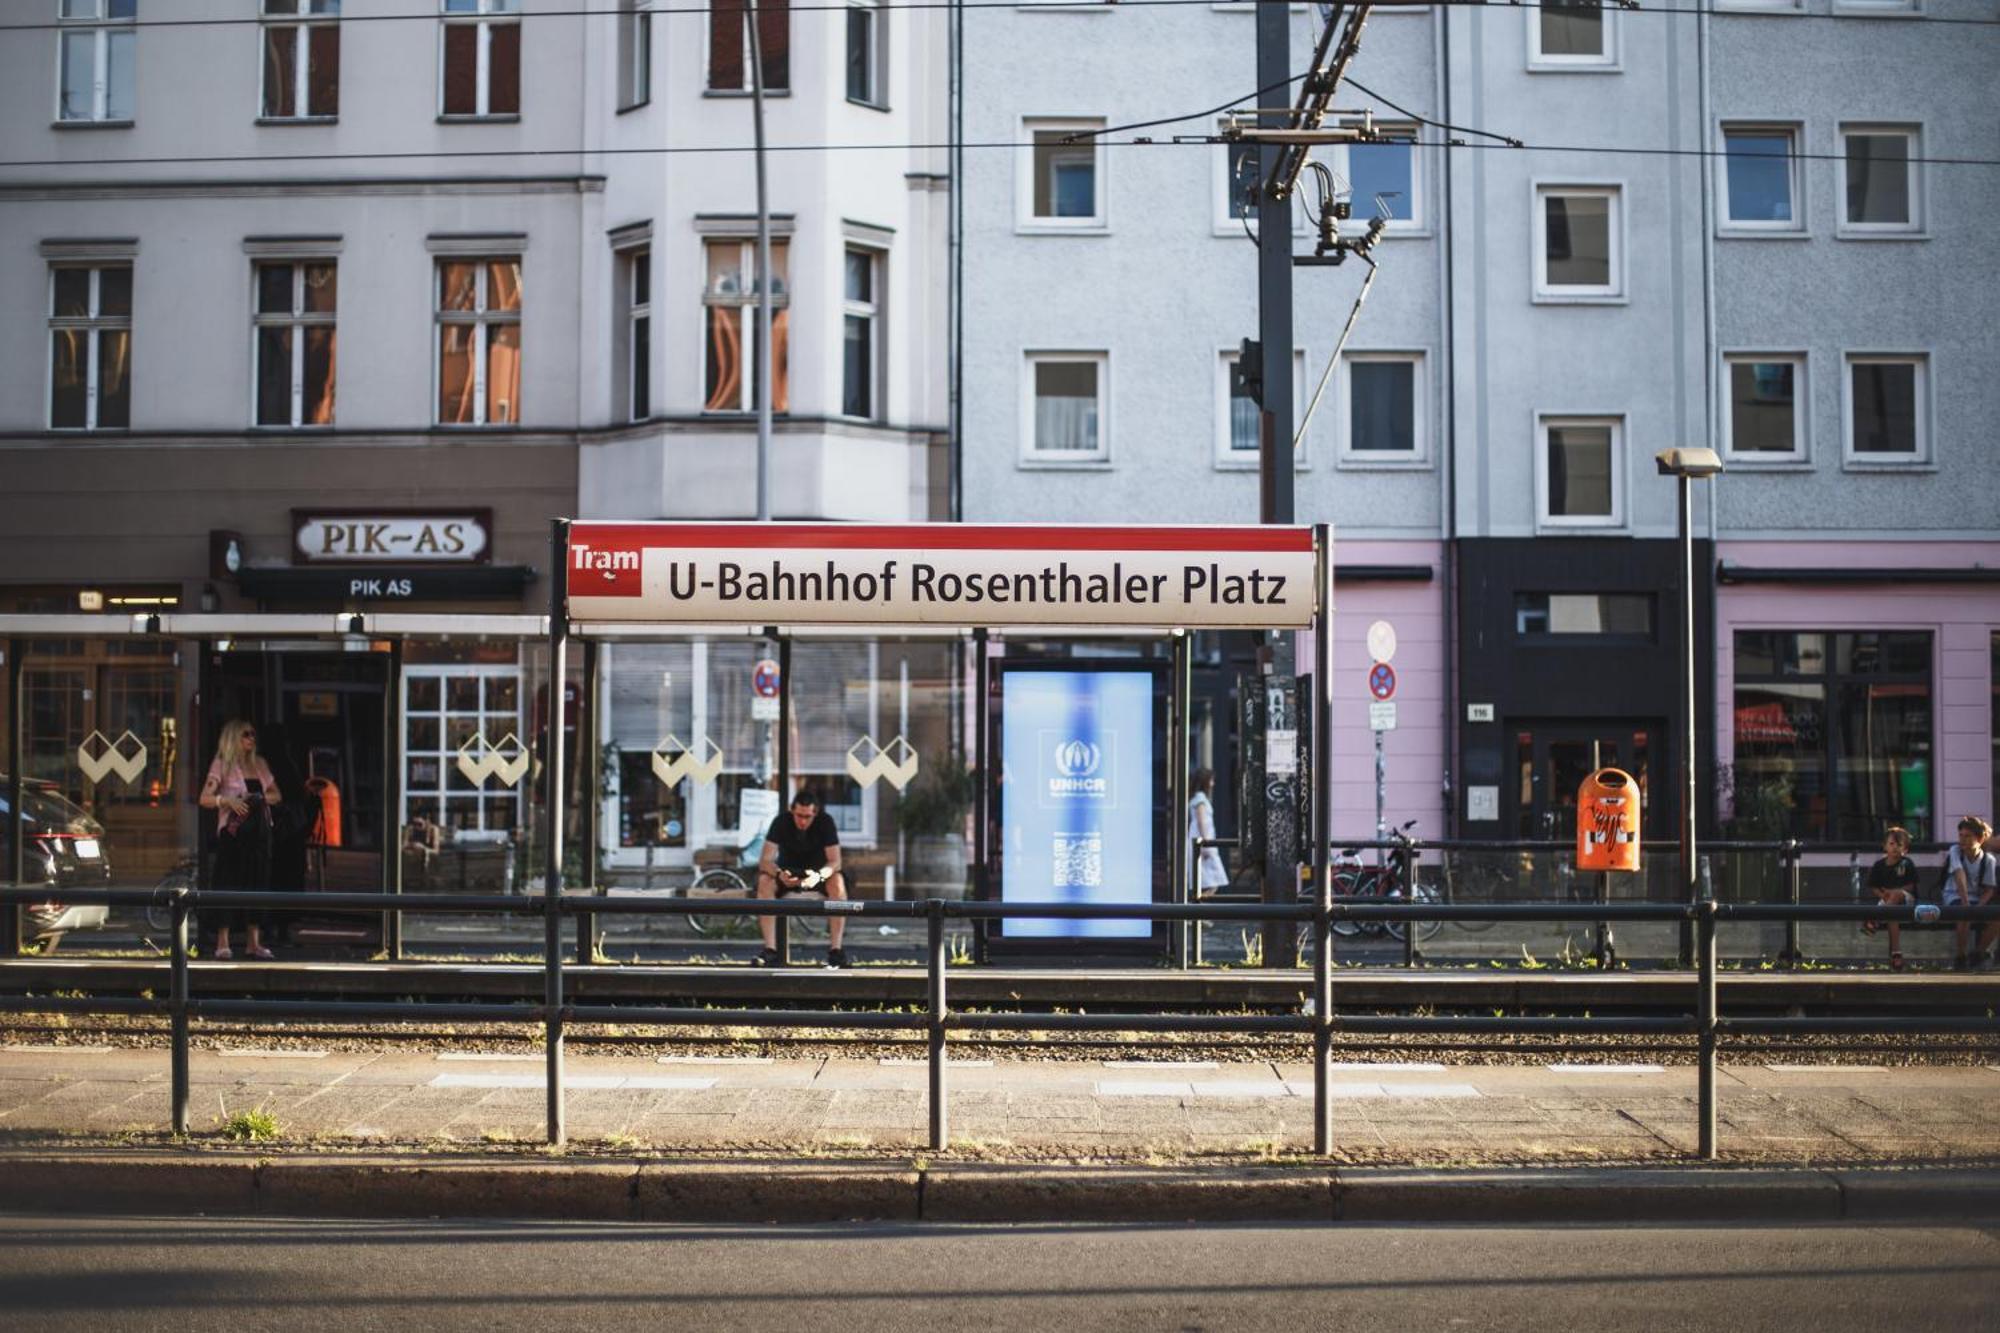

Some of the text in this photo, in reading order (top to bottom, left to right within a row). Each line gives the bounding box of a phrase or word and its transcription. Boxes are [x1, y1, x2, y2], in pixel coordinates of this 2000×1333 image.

[571, 545, 638, 569] Tram
[351, 580, 412, 595] PIK AS
[670, 561, 1286, 604] U-Bahnhof Rosenthaler Platz
[1049, 778, 1106, 791] UNHCR
